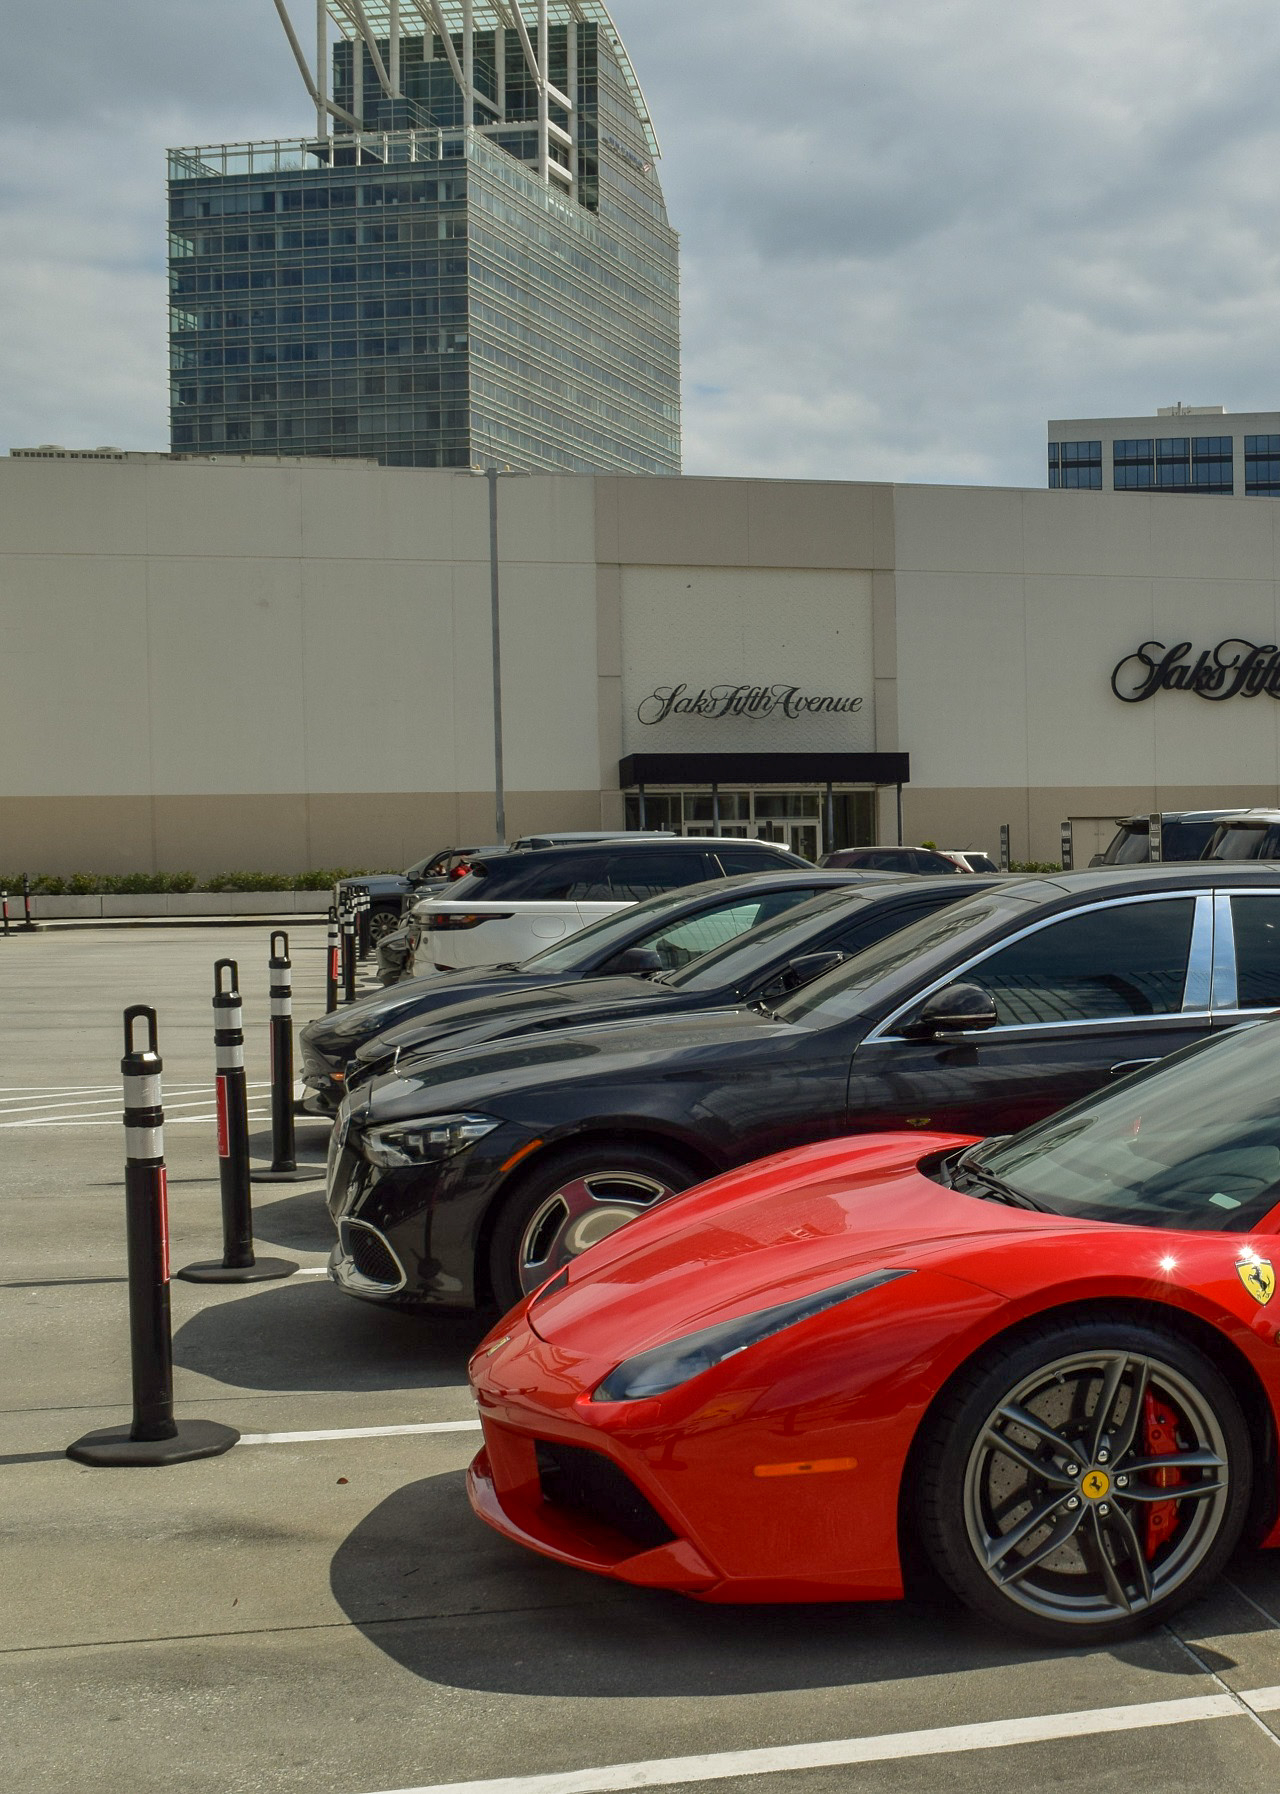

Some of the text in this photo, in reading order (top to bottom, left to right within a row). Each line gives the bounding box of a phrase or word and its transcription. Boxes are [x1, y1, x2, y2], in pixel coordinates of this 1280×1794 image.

[1111, 641, 1226, 703] Saks
[637, 683, 863, 725] Saks Fifth Avenue
